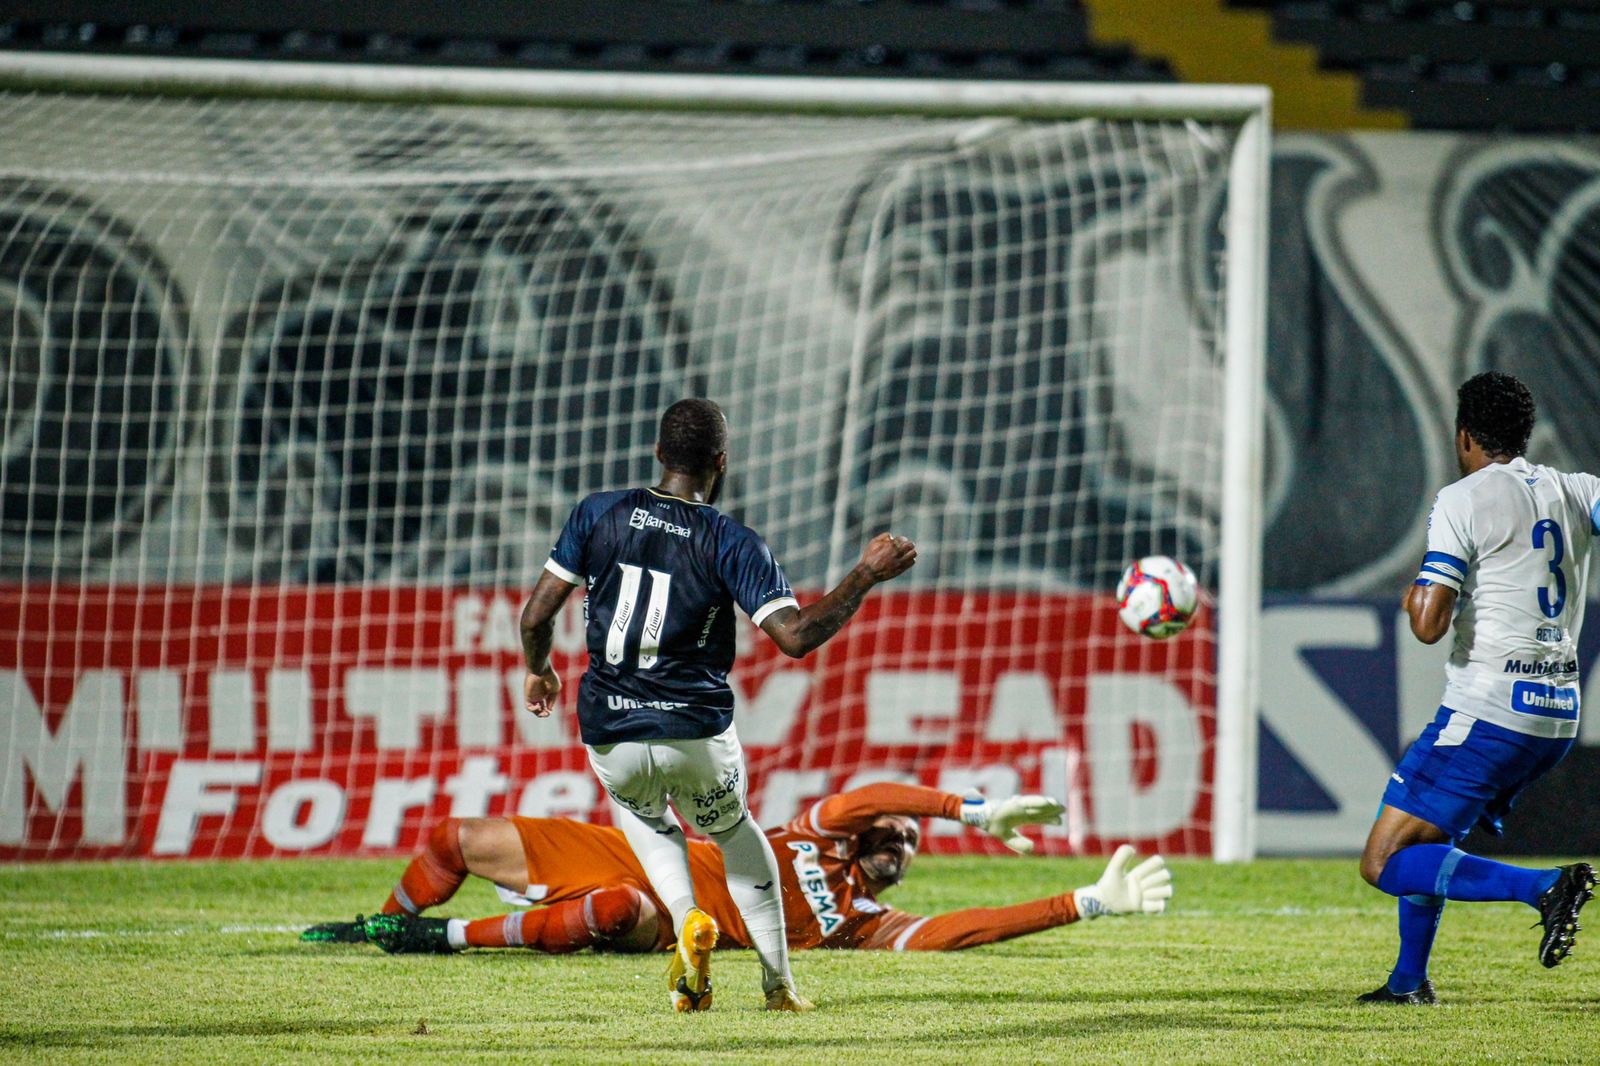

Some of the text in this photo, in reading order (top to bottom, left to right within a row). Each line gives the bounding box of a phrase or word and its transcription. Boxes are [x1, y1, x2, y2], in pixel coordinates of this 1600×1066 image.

[645, 515, 691, 539] Banpará
[1532, 518, 1567, 619] 3
[605, 563, 672, 670] 11
[612, 599, 632, 633] Zilmar
[643, 606, 663, 641] Zilmar
[1522, 690, 1574, 711] Unimed
[151, 754, 598, 855] Forte
[692, 768, 739, 808] TODOS
[786, 840, 845, 938] PISMA
